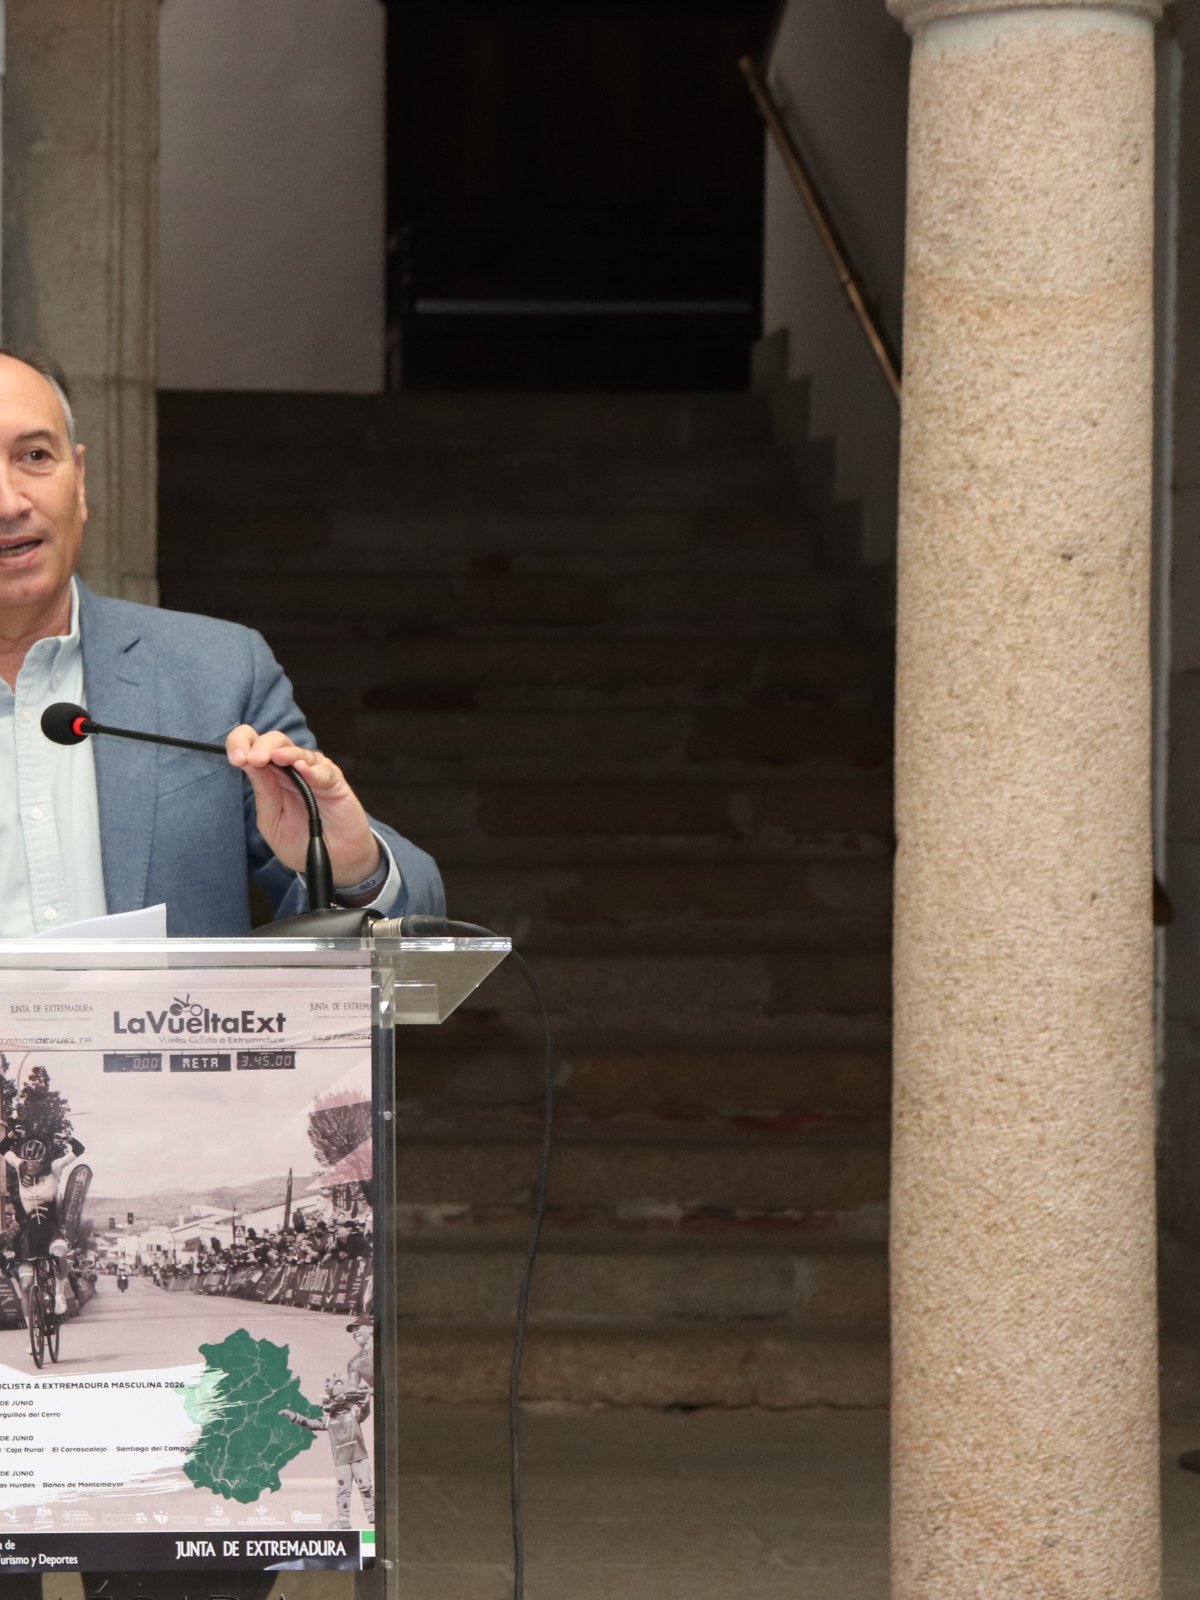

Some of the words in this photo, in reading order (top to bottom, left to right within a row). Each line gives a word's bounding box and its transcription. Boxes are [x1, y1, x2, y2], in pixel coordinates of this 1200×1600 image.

[10, 1005, 30, 1014] JUNTA
[33, 1005, 42, 1013] DE
[44, 1004, 94, 1013] EXTREMADURA
[310, 1003, 329, 1012] JUNTA
[332, 1003, 341, 1011] DE
[113, 1008, 287, 1034] LaVueltaExt
[159, 1036, 186, 1044] Vuelta
[227, 1036, 285, 1044] Extremadura
[182, 1057, 219, 1069] META
[241, 1055, 292, 1067] 3.45.00
[163, 1445, 190, 1453] Campo
[78, 1481, 124, 1489] Montemayor
[4, 1539, 16, 1550] de
[175, 1541, 216, 1560] JUNTA
[223, 1541, 240, 1556] DE
[246, 1540, 347, 1556] EXTREMADURA
[31, 1556, 37, 1567] y
[38, 1553, 79, 1567] Deportes
